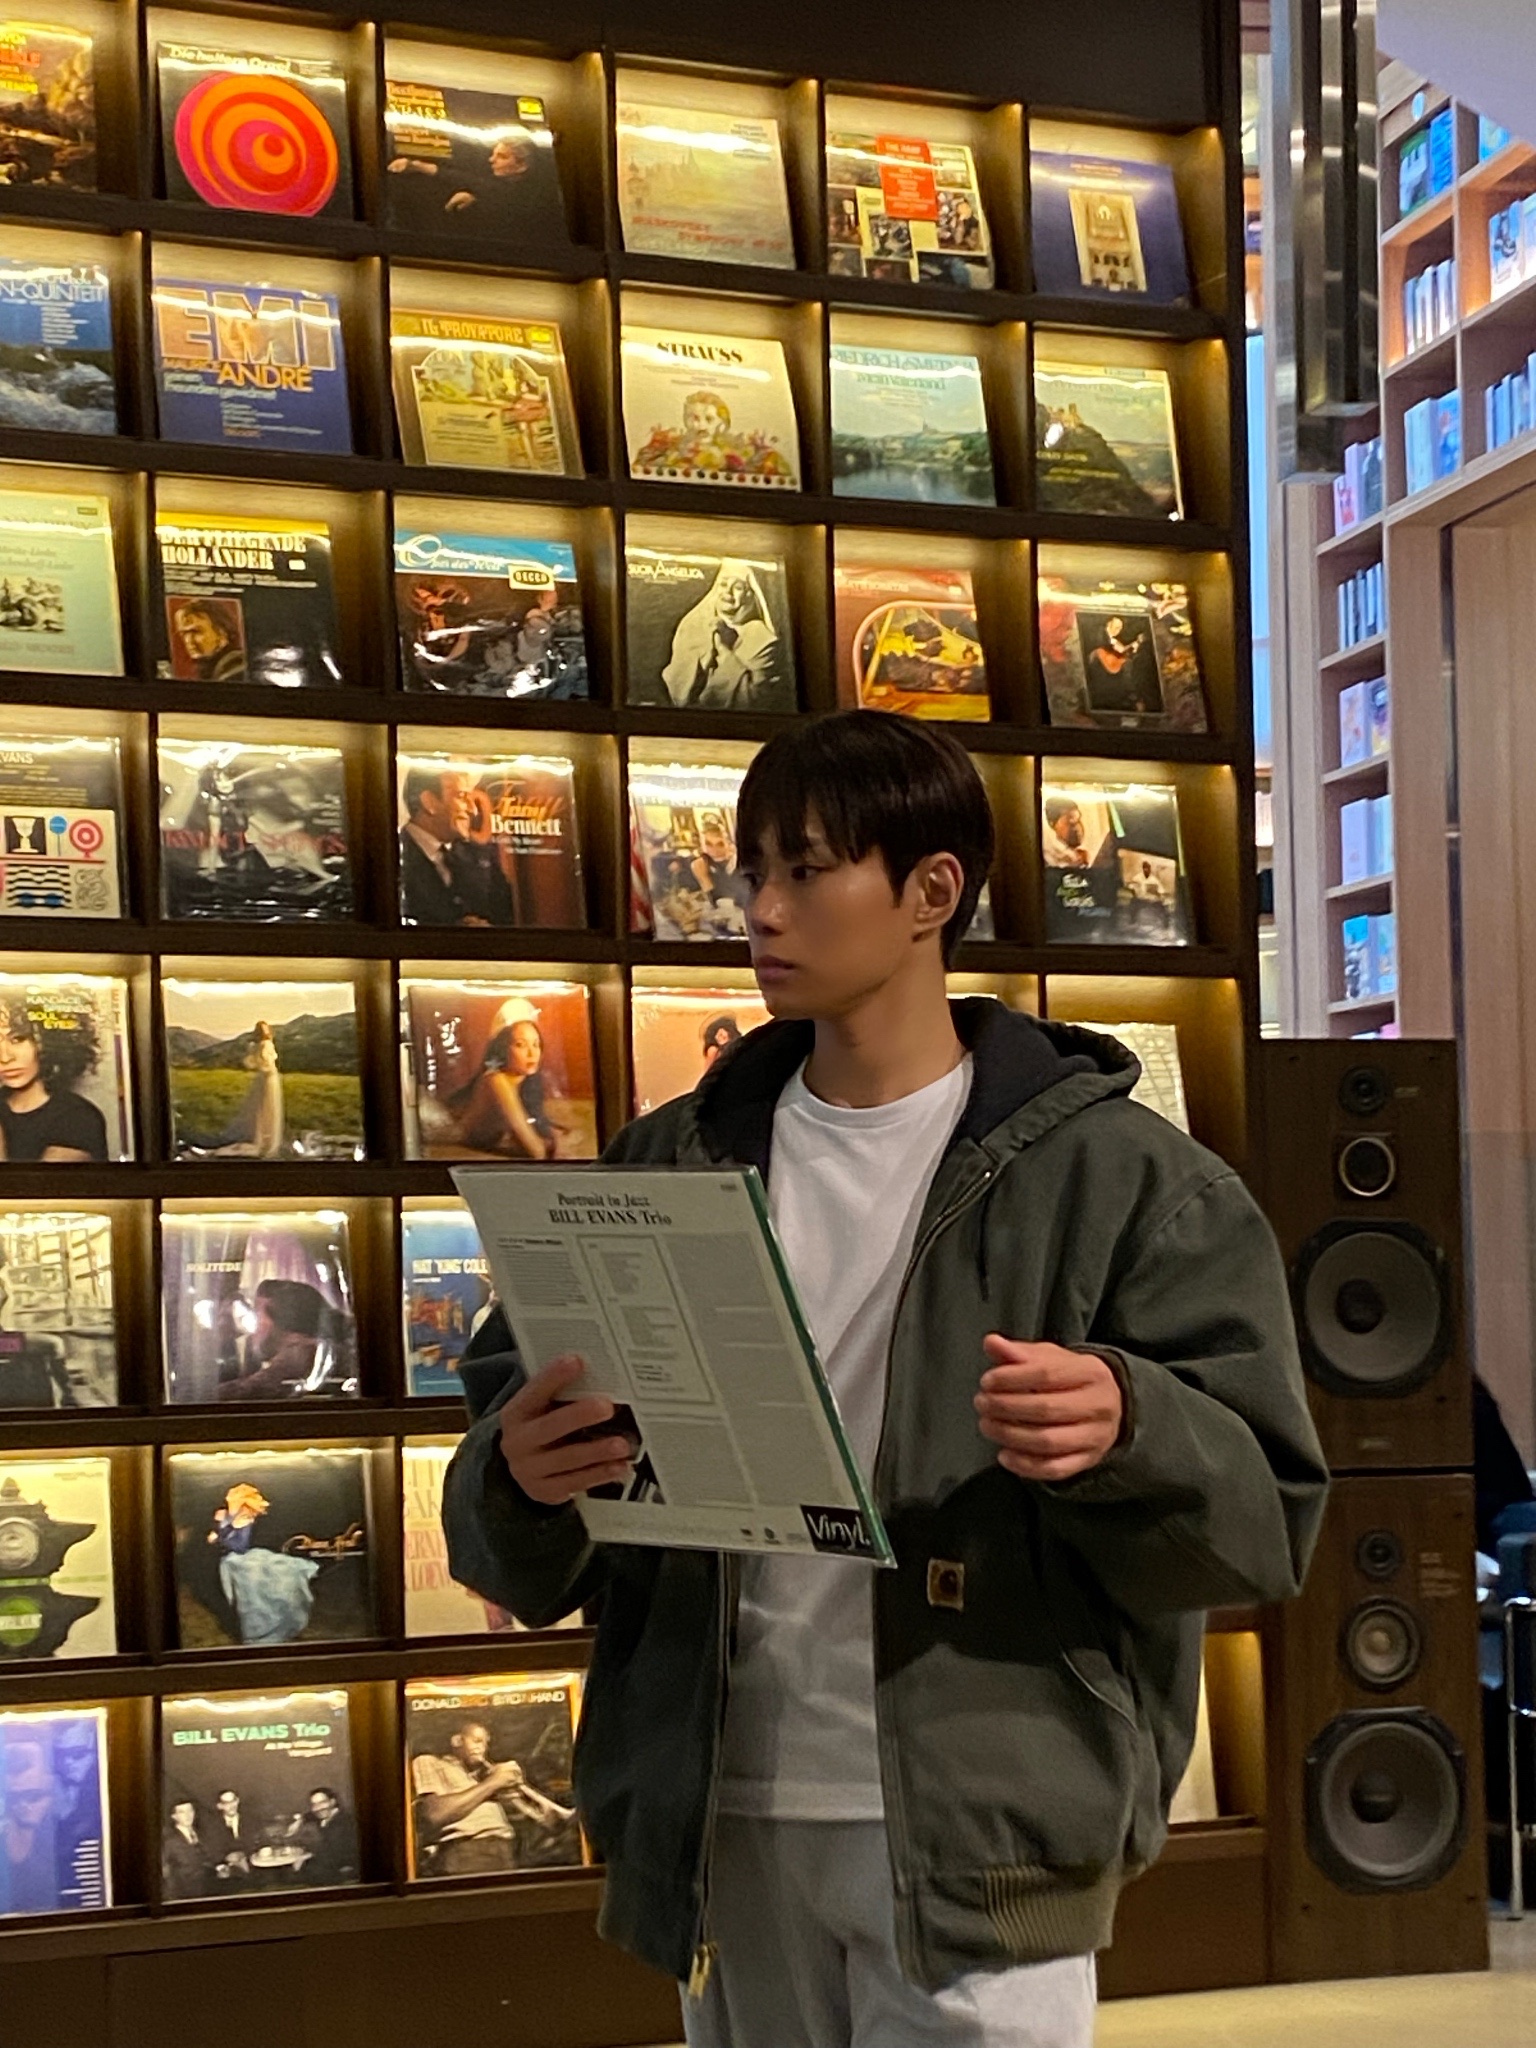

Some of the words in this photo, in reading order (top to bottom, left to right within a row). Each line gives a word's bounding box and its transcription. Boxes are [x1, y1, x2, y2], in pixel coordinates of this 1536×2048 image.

[154, 285, 337, 372] EMI
[656, 341, 743, 363] STRAUSS
[0, 751, 34, 765] VANS
[490, 812, 563, 837] Bennett
[27, 1010, 59, 1022] SOUL
[623, 1193, 650, 1208] Jazz
[548, 1208, 584, 1224] BILL
[588, 1208, 638, 1225] EVANS
[642, 1209, 673, 1226] Trio
[172, 1729, 218, 1746] BILL
[221, 1723, 289, 1743] EVANS
[291, 1722, 331, 1737] Trio
